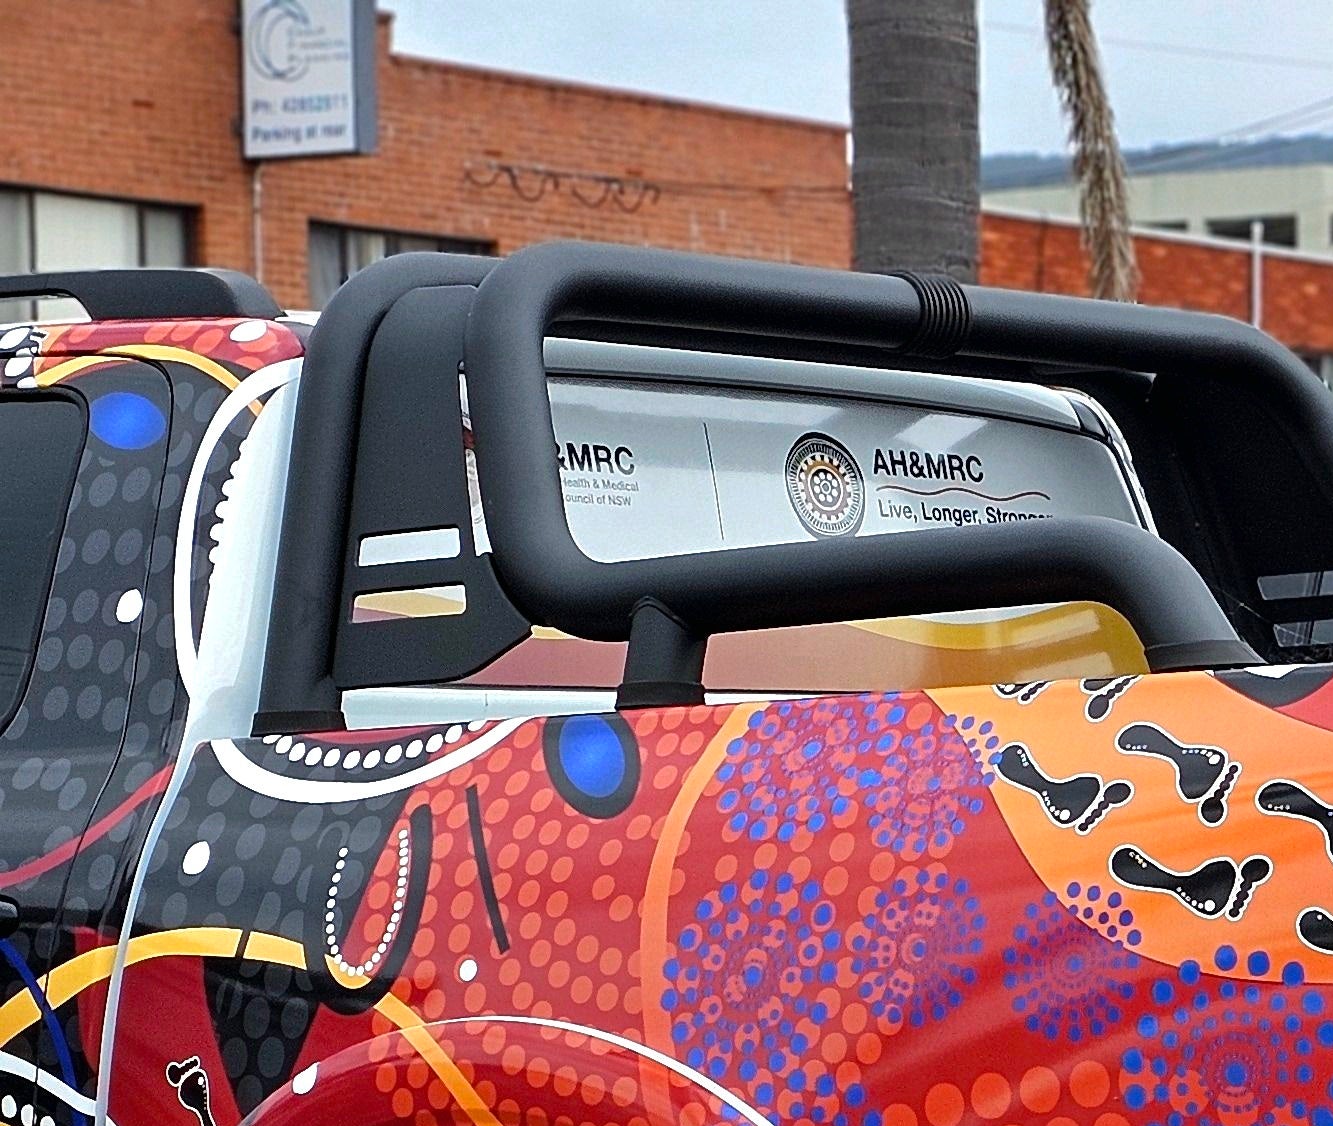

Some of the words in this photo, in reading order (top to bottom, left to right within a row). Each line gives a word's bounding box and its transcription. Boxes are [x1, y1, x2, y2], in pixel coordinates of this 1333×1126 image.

[252, 126, 302, 143] Parking
[306, 124, 318, 138] at
[873, 448, 984, 483] AH&MRC
[602, 479, 639, 492] Medical
[596, 494, 606, 505] of
[608, 494, 632, 506] NSW
[877, 498, 918, 523] Live,
[920, 501, 982, 527] Longer,
